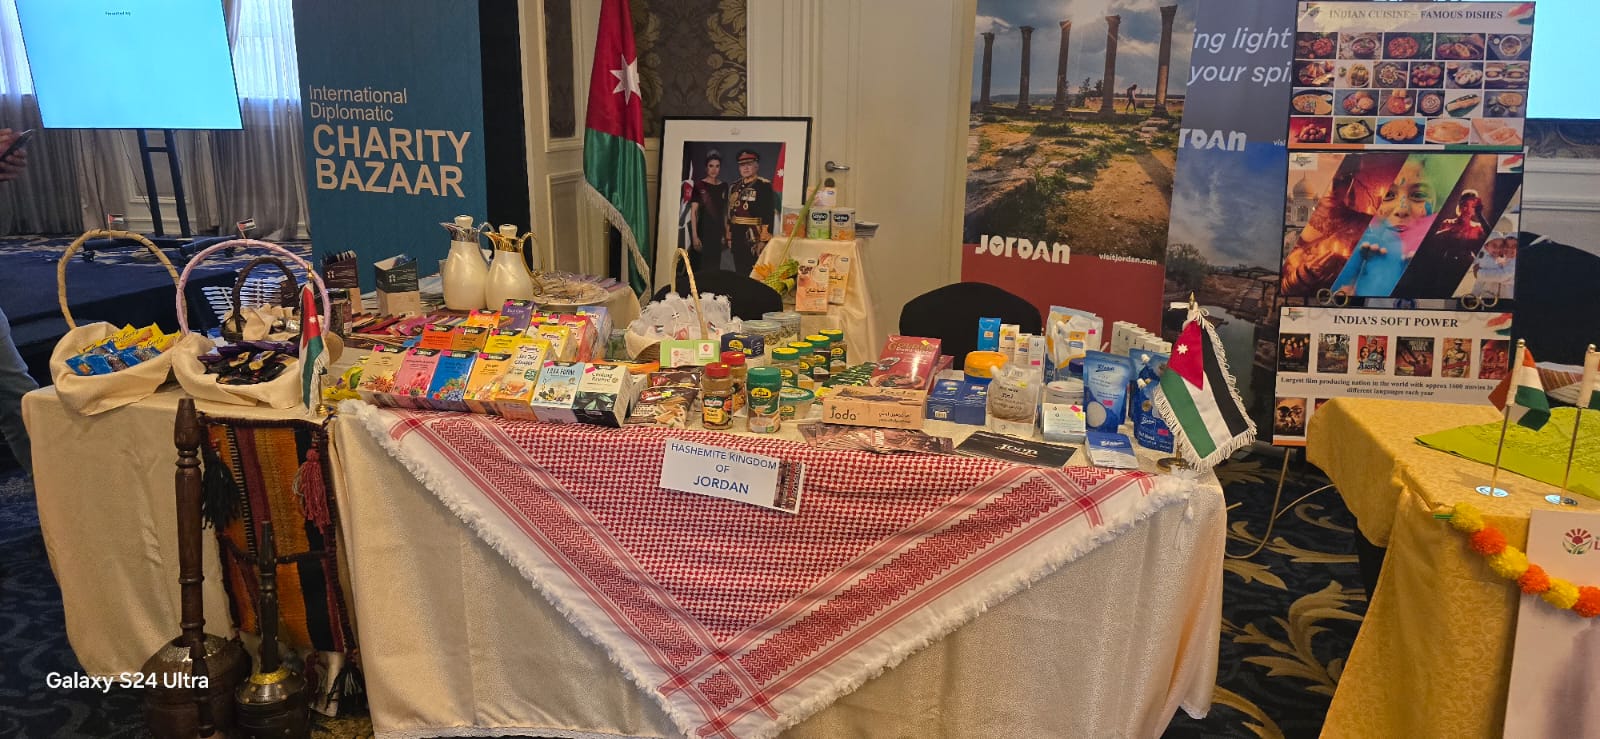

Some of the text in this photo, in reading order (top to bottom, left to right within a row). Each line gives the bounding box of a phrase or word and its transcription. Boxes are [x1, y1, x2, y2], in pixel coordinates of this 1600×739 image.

[1329, 9, 1366, 19] INDIAN
[1368, 9, 1409, 19] CUISINE
[1420, 10, 1462, 20] FAMOUS
[1465, 10, 1503, 20] DISHES
[1232, 26, 1292, 54] light
[1186, 61, 1292, 87] your spi
[308, 84, 408, 104] International
[309, 101, 394, 122] Diplomatic
[312, 123, 472, 164] CHARITY
[315, 157, 466, 198] BAZAAR
[974, 234, 1071, 265] JORDAN
[1098, 253, 1158, 266] visitjordan.com
[1333, 315, 1459, 328] INDIA'S SOFT POWER
[1280, 377, 1304, 385] Largest
[1319, 379, 1350, 387] producing
[829, 405, 857, 421] Joda
[671, 443, 777, 470] HASHEMITE KINGDOM
[715, 464, 730, 473] OF
[693, 475, 749, 494] JORDAN
